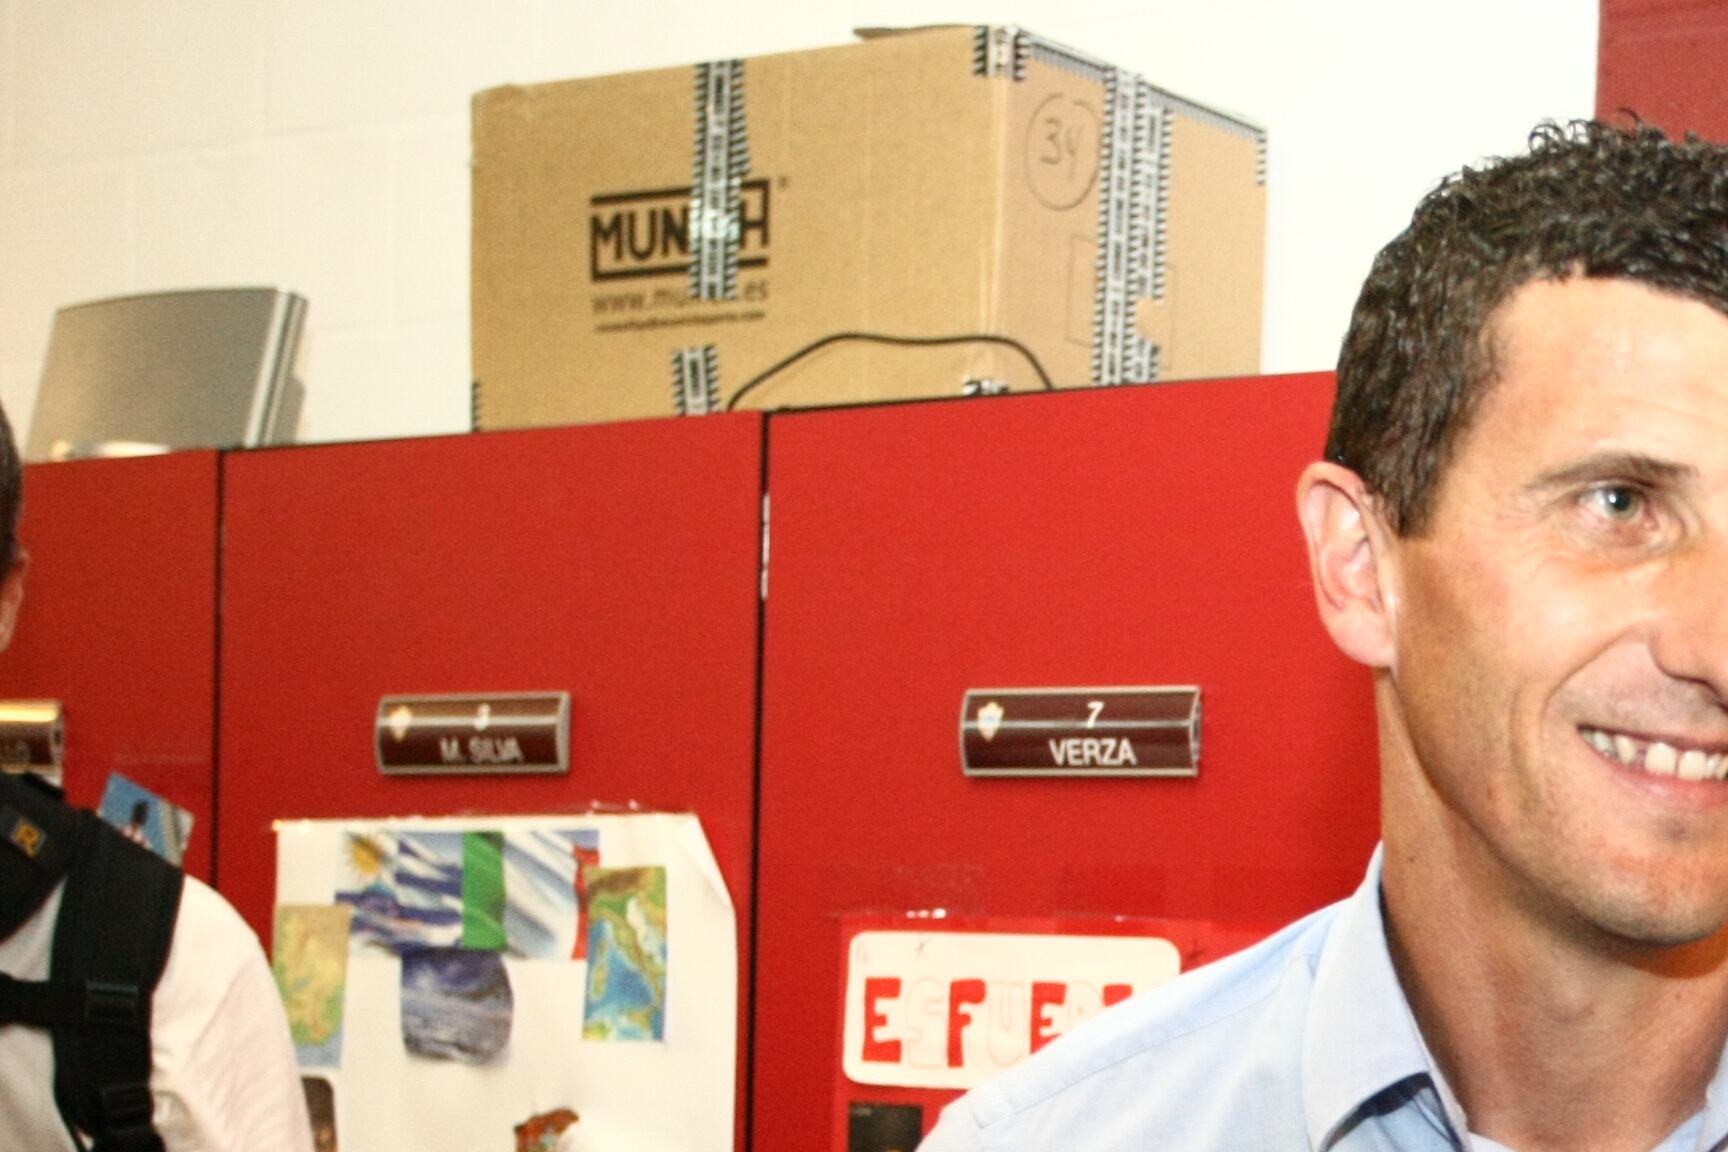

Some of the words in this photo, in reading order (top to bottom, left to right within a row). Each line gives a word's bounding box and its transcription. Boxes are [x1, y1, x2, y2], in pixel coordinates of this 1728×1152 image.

[590, 198, 768, 262] MUNH
[1087, 700, 1105, 729] 7
[1048, 737, 1138, 766] VERZA
